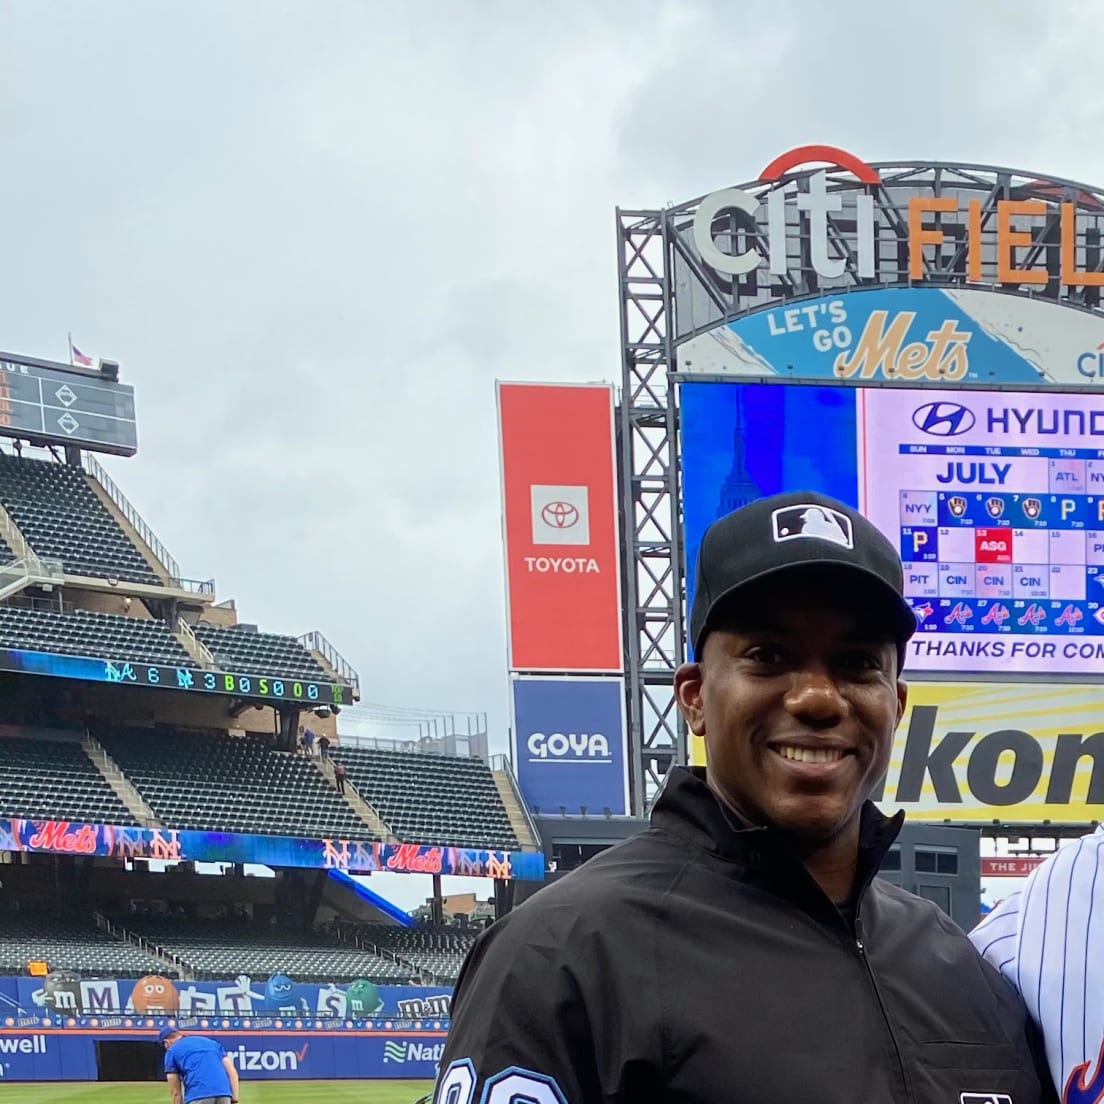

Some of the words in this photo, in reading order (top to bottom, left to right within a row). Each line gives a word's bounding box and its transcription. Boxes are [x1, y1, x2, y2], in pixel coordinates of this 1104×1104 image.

[767, 301, 848, 336] LET'S
[812, 325, 853, 352] GO
[834, 310, 974, 380] Mets
[946, 446, 966, 454] MON
[985, 447, 1002, 455] TUE
[1059, 449, 1076, 457] THU
[936, 462, 1012, 485] JULY
[1055, 472, 1079, 481] ATL
[905, 503, 932, 513] NYY
[980, 541, 1007, 551] ASG
[524, 556, 600, 573] TOYOTA
[910, 575, 930, 584] PIT
[946, 576, 967, 585] CIN
[983, 576, 1004, 585] CIN
[1020, 577, 1041, 586] CIN
[911, 640, 1005, 658] THANKS
[1010, 642, 1057, 659] FOR
[148, 667, 160, 683] 6
[204, 674, 216, 689] 3
[225, 675, 235, 690] B
[259, 679, 268, 694] S
[528, 732, 610, 757] GOYA
[29, 821, 97, 854] Mets
[387, 843, 444, 874] Mets
[989, 862, 1016, 871] THE
[0, 1035, 47, 1053] well
[407, 1042, 447, 1062] Nati
[230, 1045, 298, 1071] rizon
